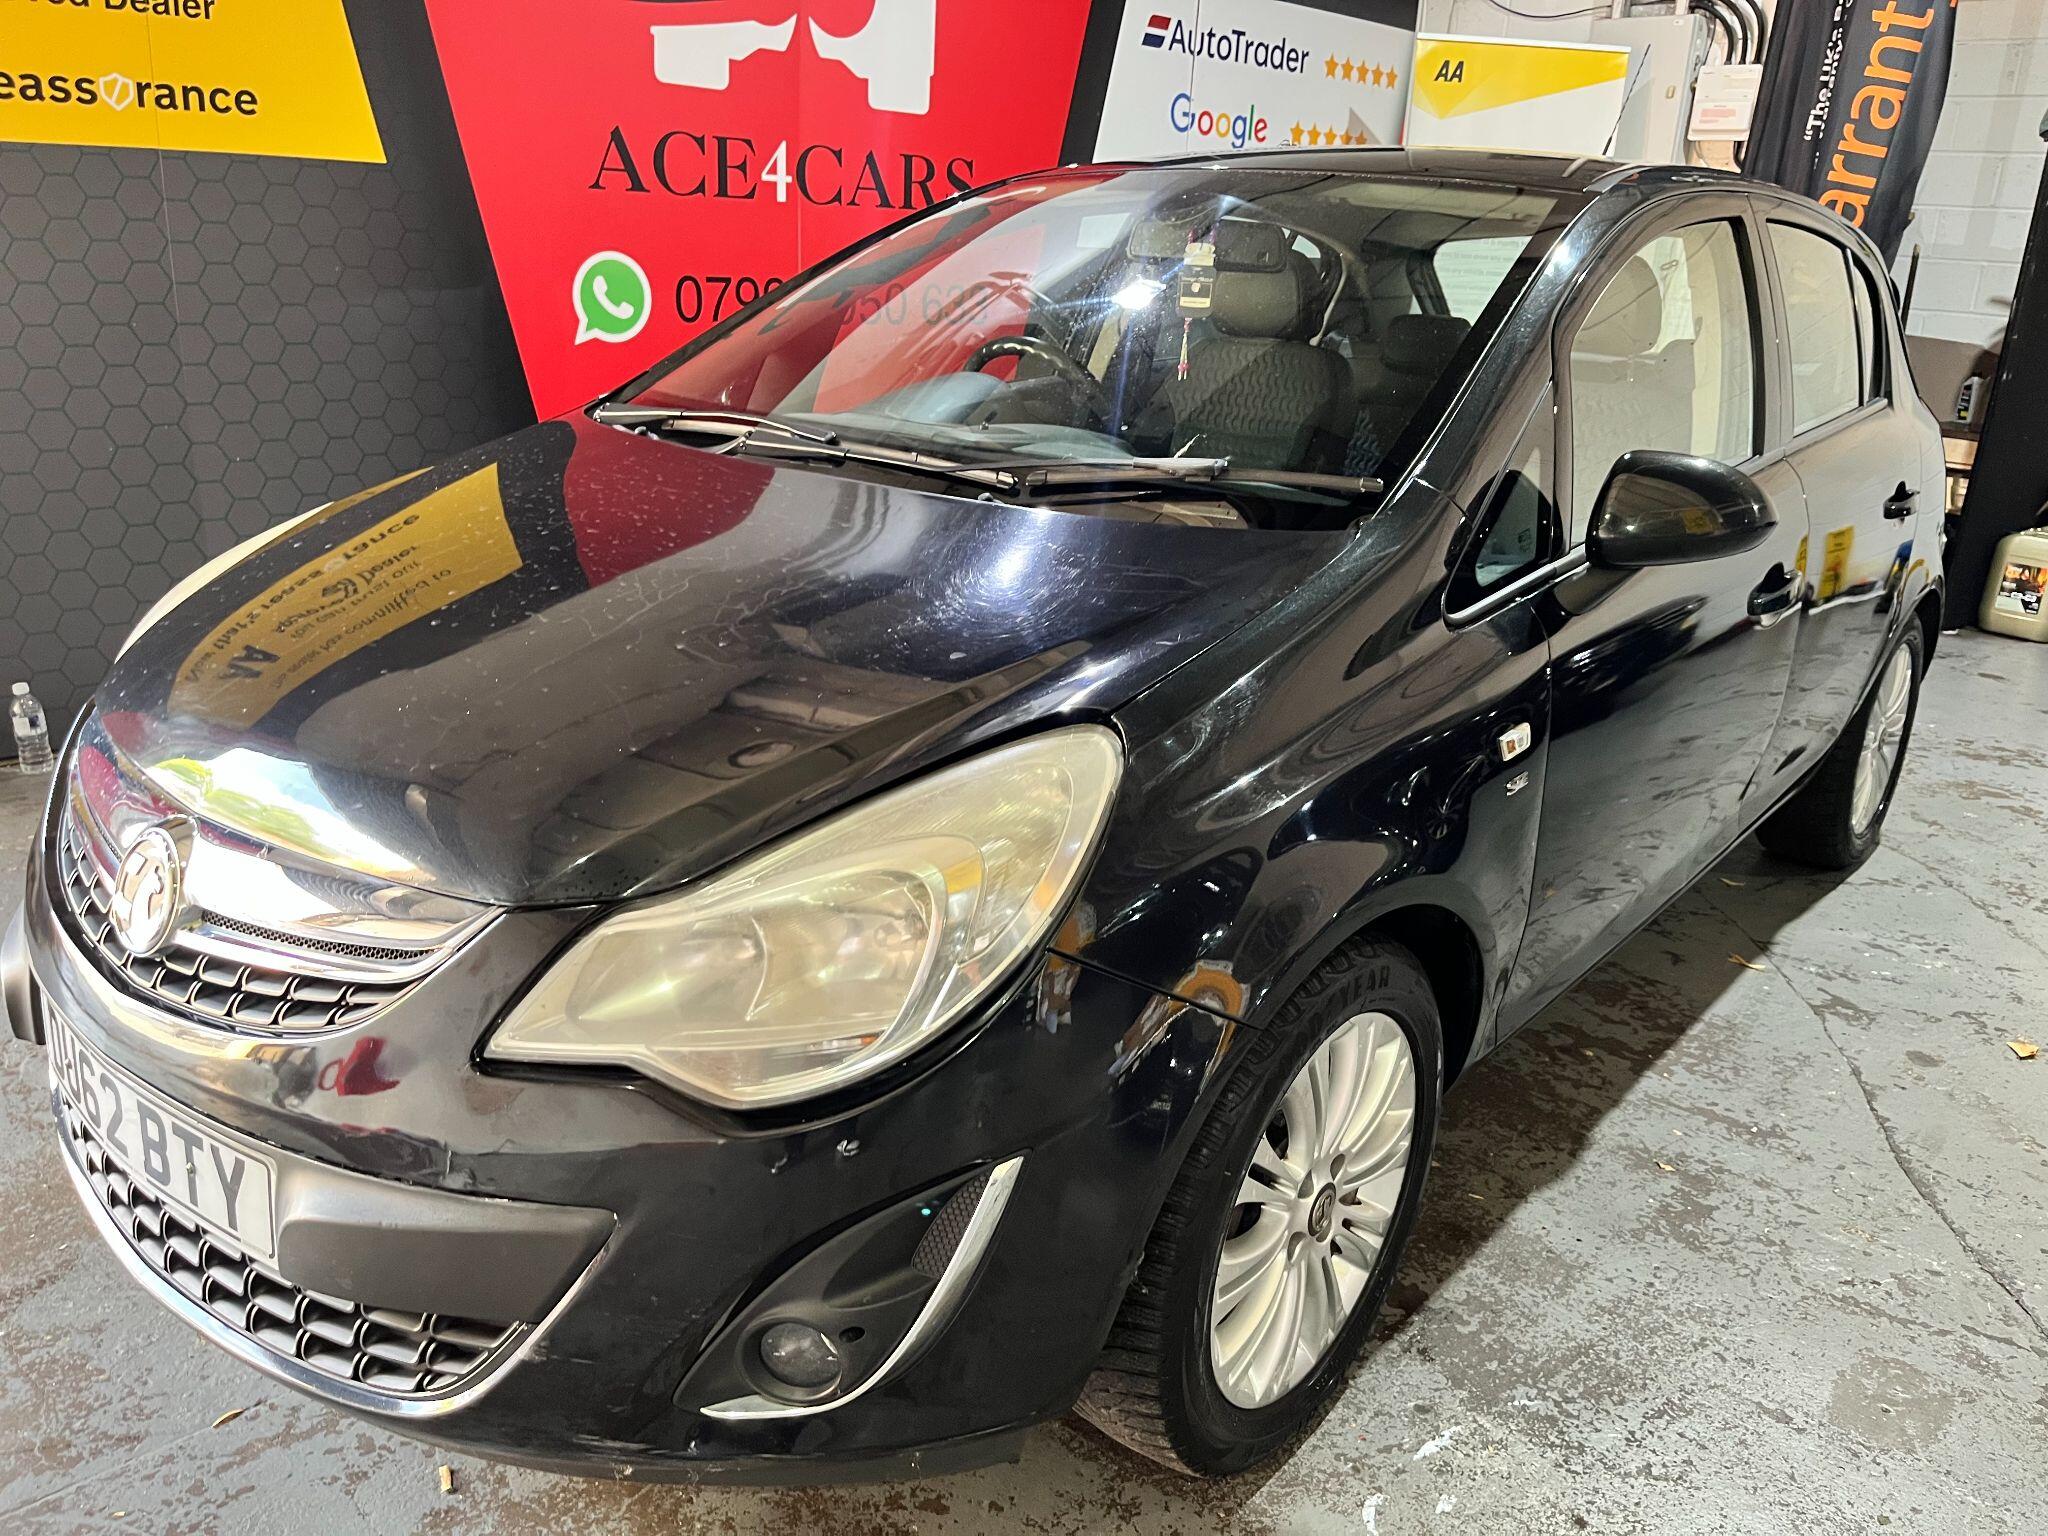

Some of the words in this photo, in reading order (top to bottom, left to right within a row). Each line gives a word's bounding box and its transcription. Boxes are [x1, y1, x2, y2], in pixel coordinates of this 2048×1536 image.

[1168, 19, 1310, 75] AutoTrader
[1434, 60, 1465, 83] AA
[1170, 92, 1269, 148] Google
[1818, 0, 1958, 229] arrant
[588, 125, 976, 210] ACE4CARS
[136, 1098, 246, 1232] BTY
